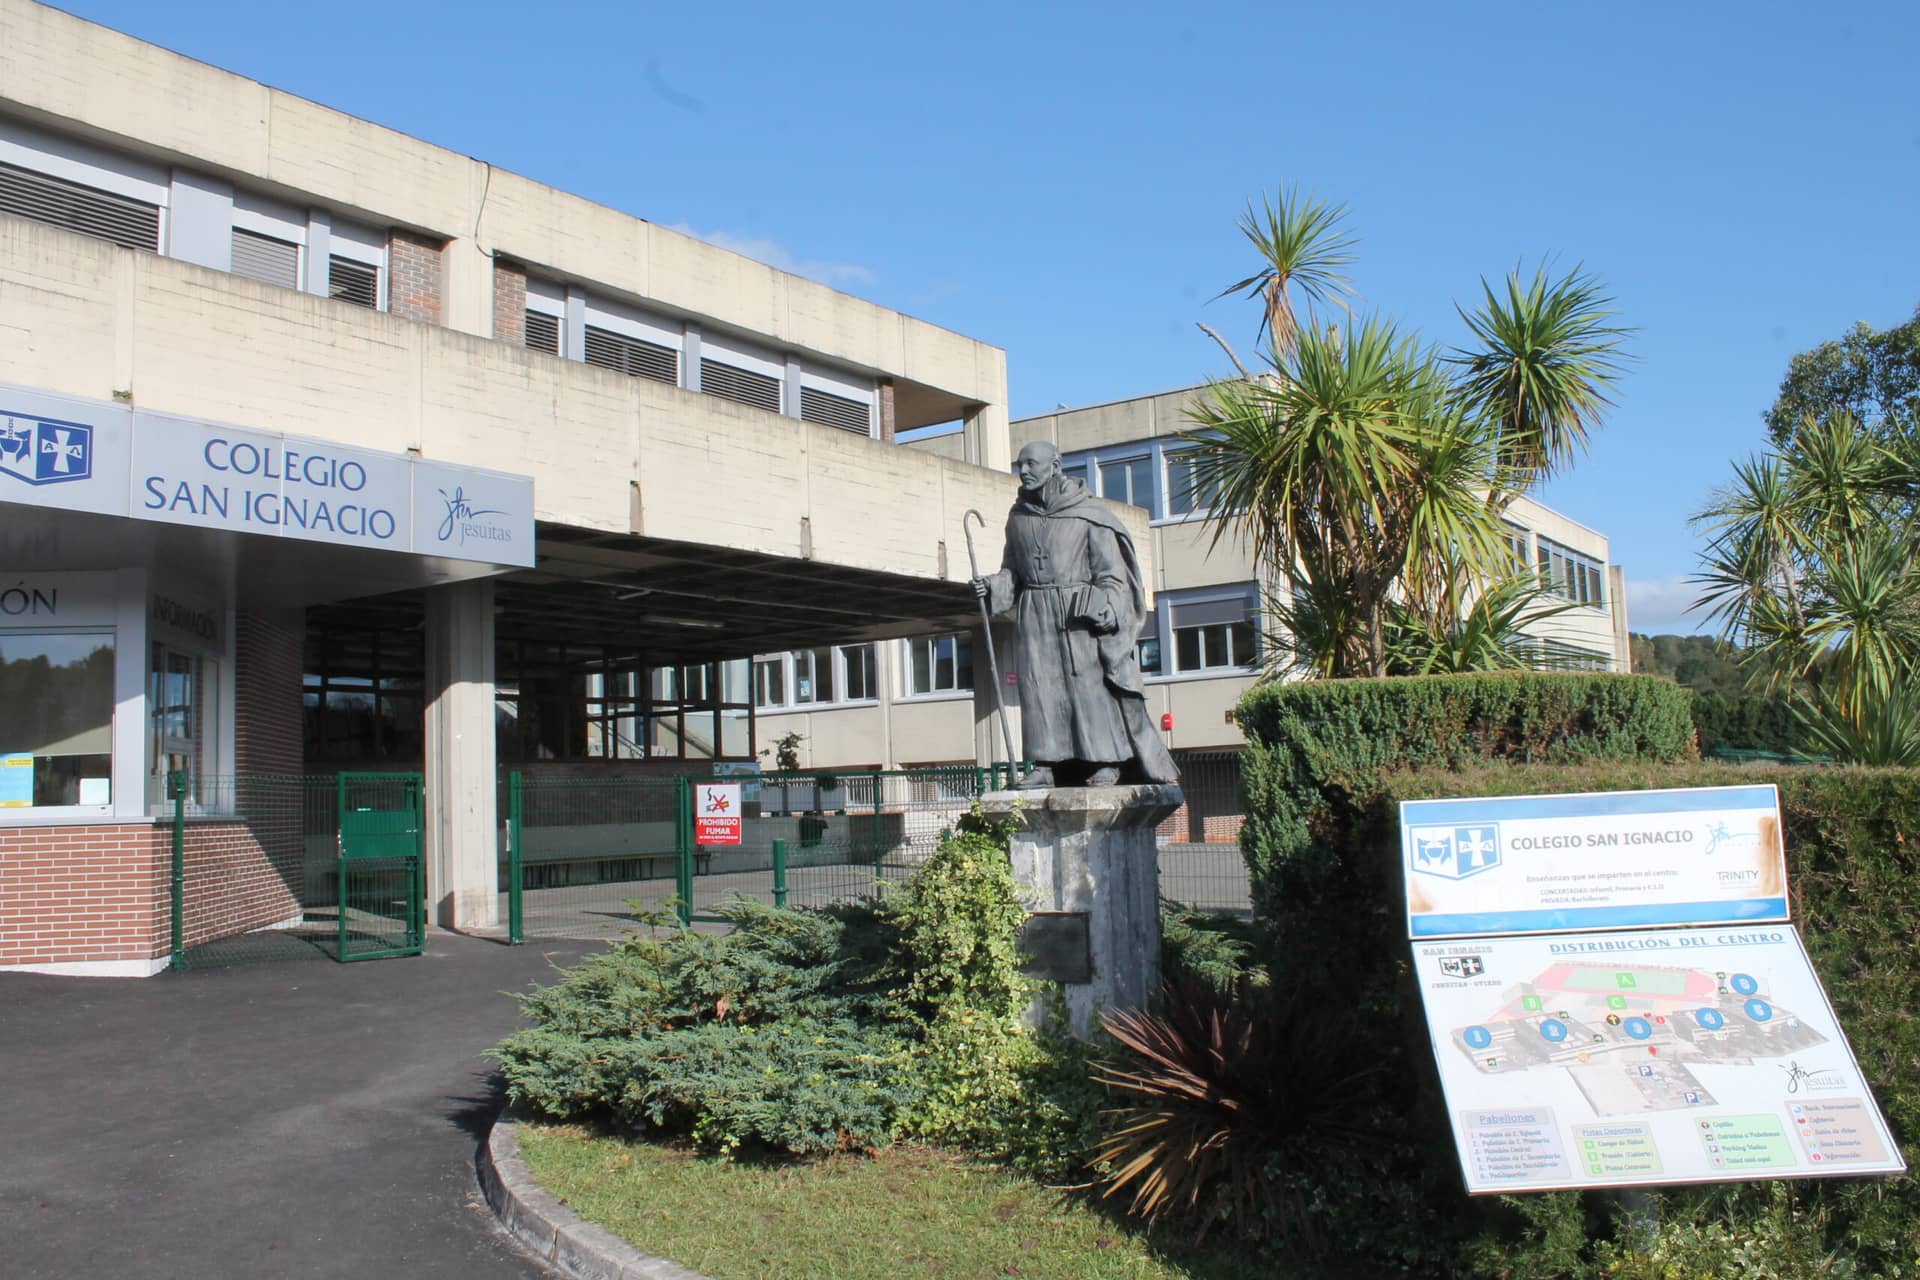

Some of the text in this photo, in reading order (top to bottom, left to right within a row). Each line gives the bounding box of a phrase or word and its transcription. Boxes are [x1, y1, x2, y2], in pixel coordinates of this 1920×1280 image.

[204, 438, 367, 492] COLEGIO
[145, 476, 229, 519] SAN
[245, 491, 396, 539] IGNACIO
[0, 581, 57, 615] ÓN
[699, 818, 738, 826] PROHIBIDO
[705, 827, 731, 835] FUMAR
[1510, 835, 1582, 850] COLEGIO
[1587, 833, 1618, 847] SAN
[1624, 830, 1693, 845] IGNACIO
[1716, 870, 1759, 881] TRINITY
[1549, 932, 1784, 953] DISTRIBUCIÓN DEL CENTRO
